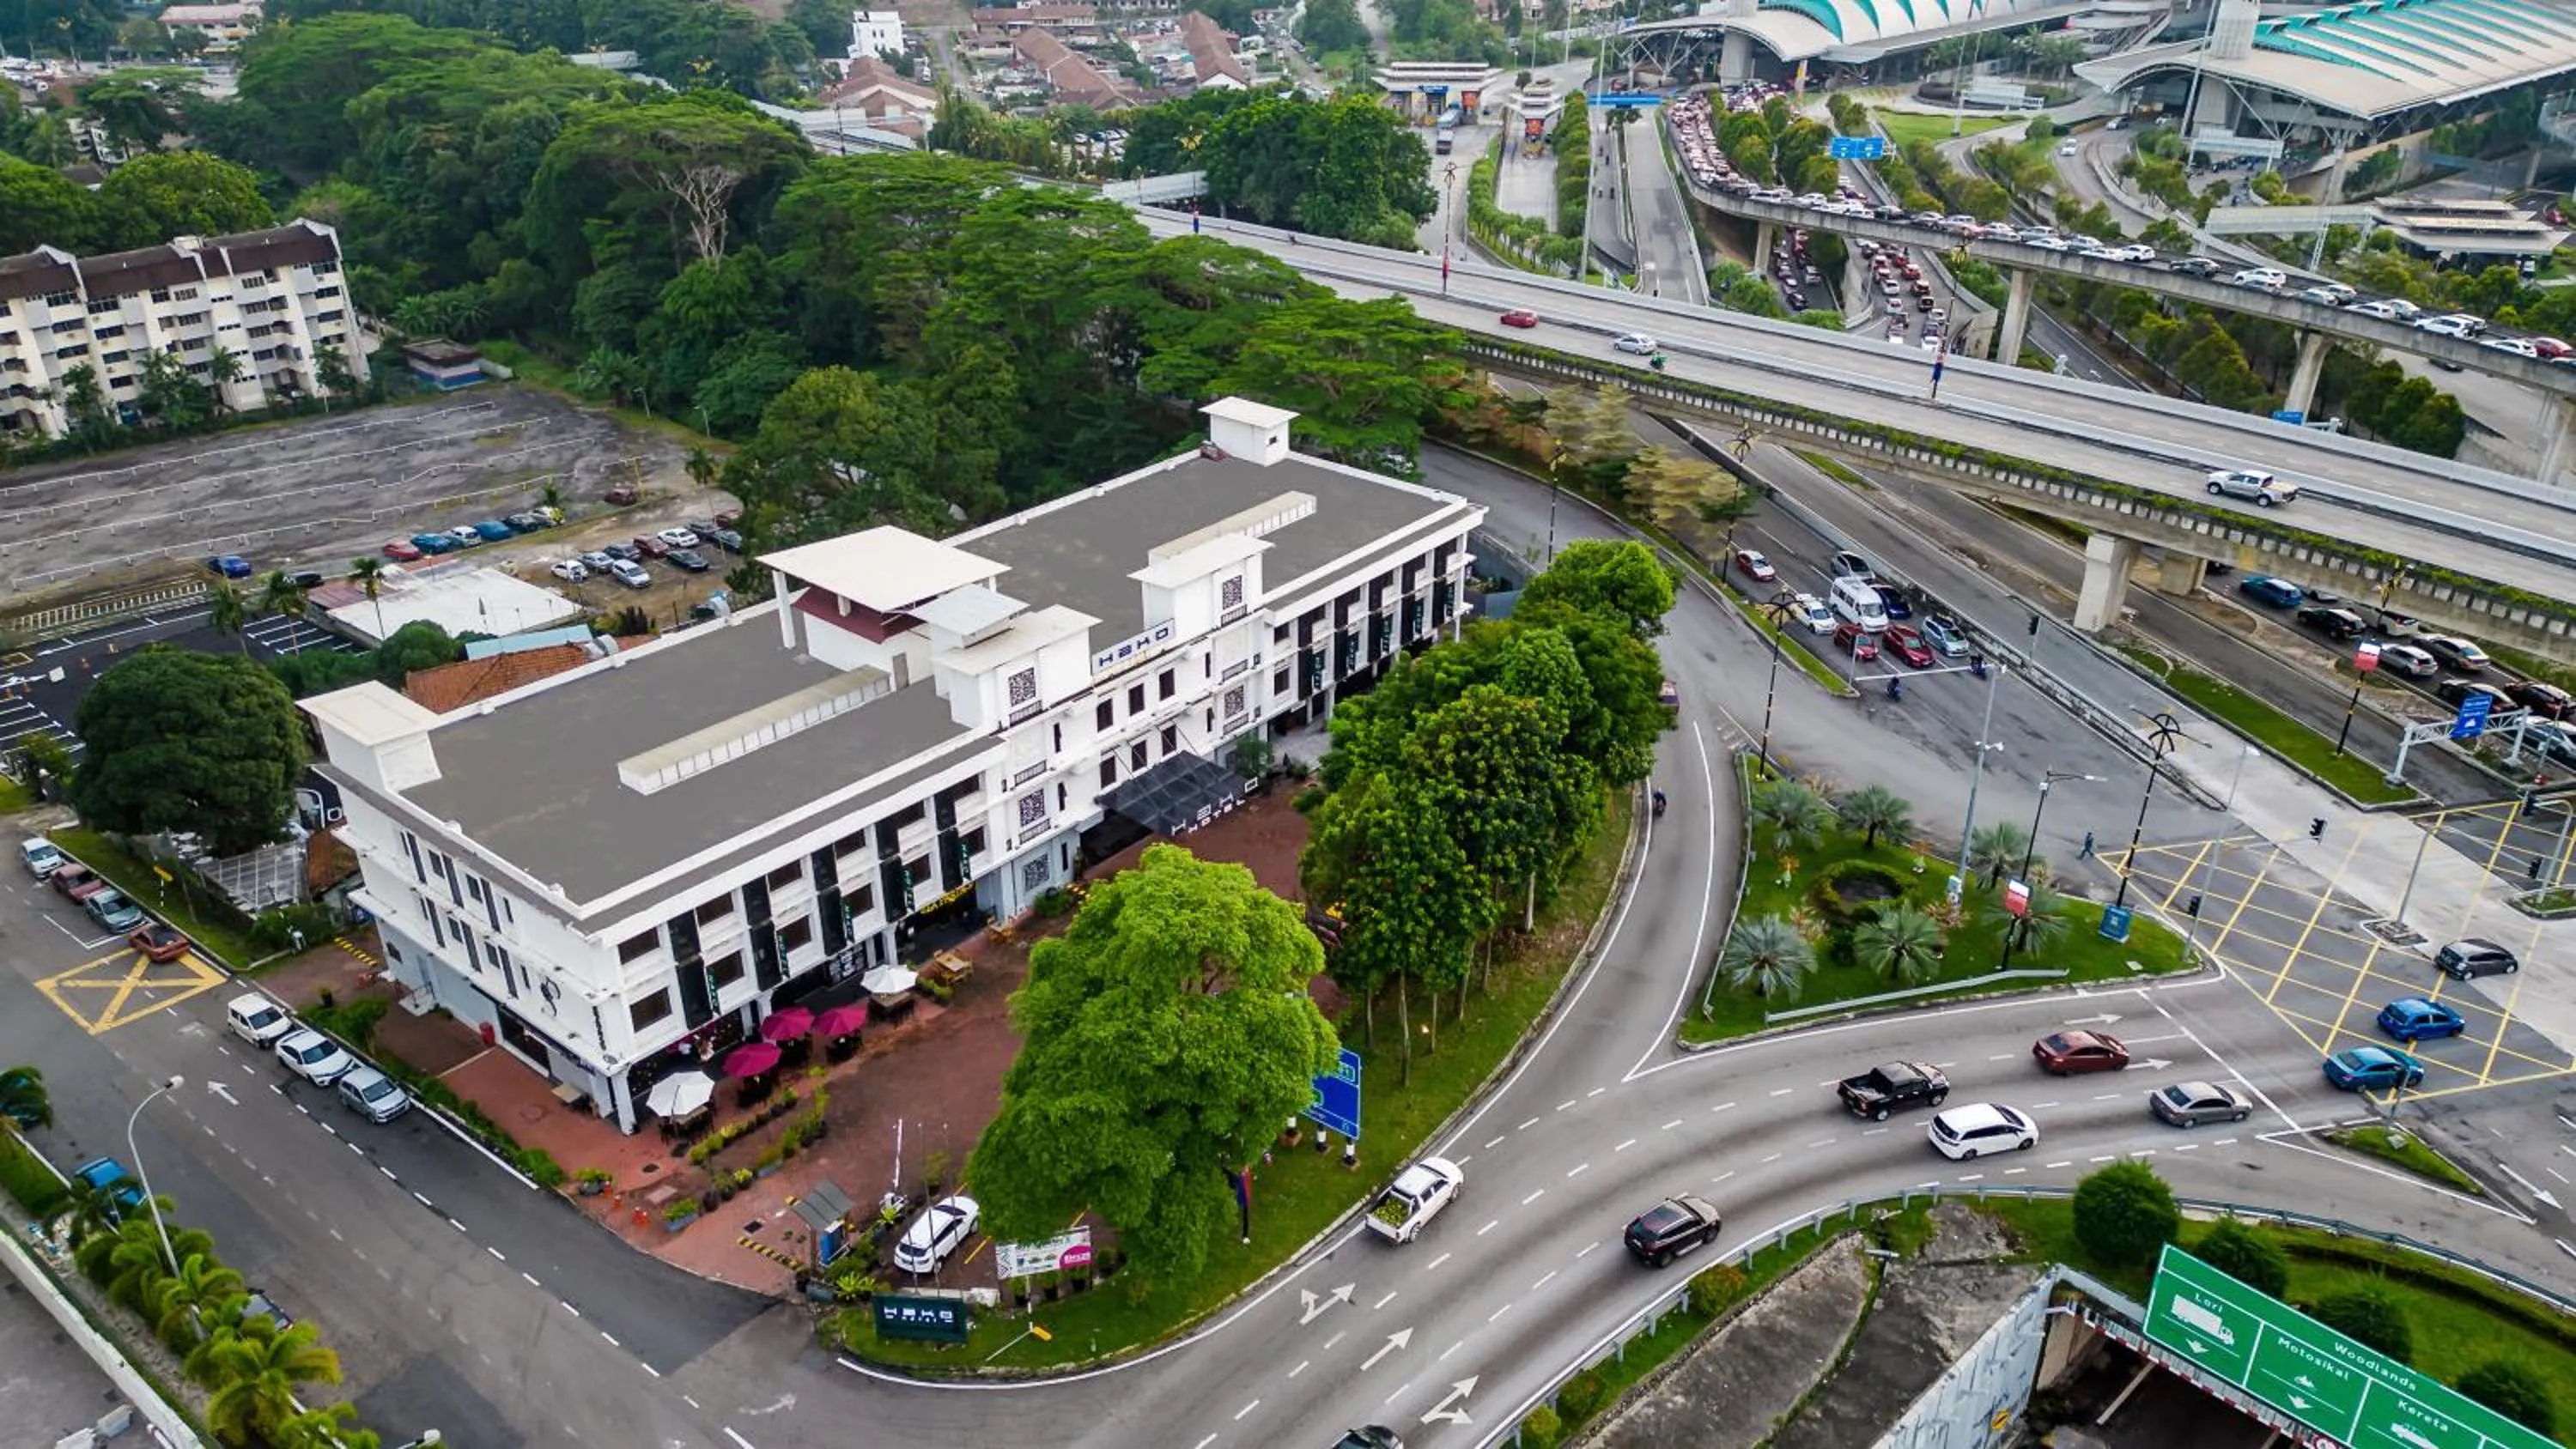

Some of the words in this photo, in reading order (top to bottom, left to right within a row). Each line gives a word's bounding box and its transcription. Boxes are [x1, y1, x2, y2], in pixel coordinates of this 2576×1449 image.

[2195, 1293, 2223, 1313] Lori
[2278, 1337, 2349, 1381] Motosikal
[2334, 1342, 2416, 1391] Woodlands
[2397, 1400, 2449, 1433] Kereta
